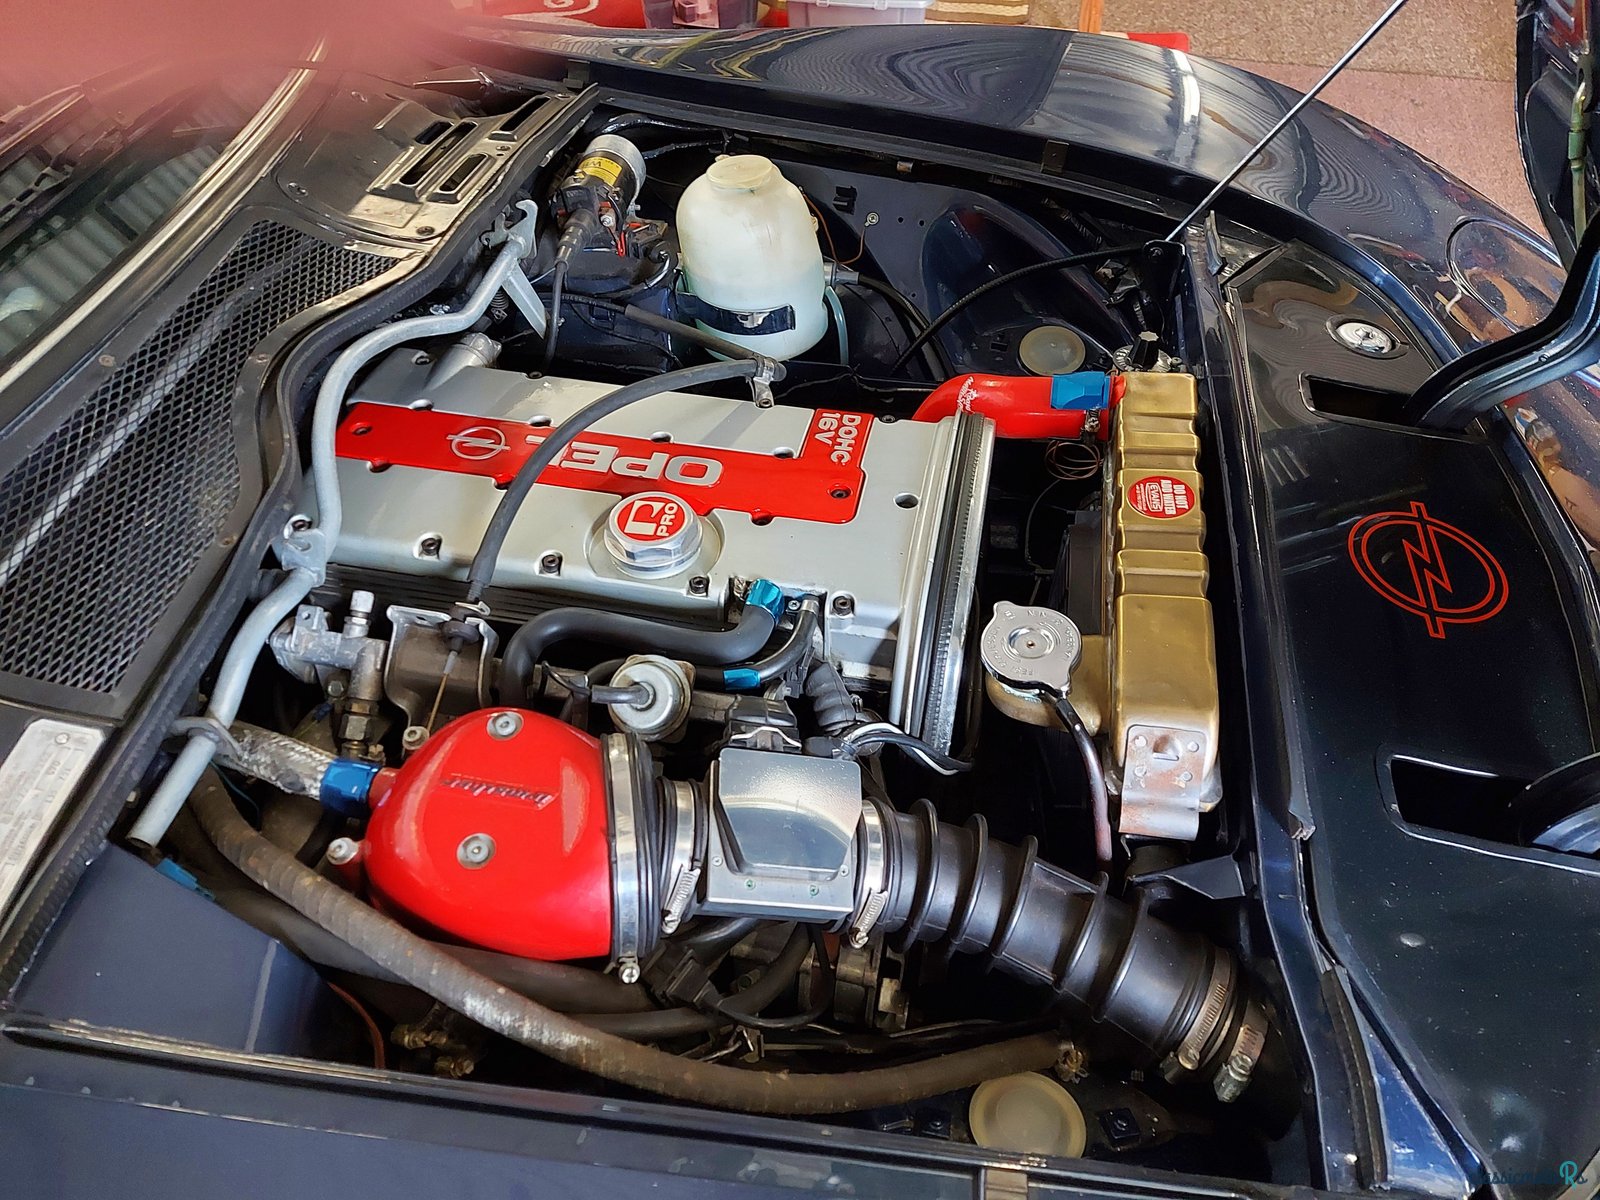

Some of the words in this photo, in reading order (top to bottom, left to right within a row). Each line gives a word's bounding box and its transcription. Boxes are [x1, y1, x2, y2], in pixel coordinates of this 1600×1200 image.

[814, 412, 841, 446] 16V
[831, 414, 862, 465] DOHC
[1150, 484, 1161, 509] EVANS
[1161, 479, 1173, 493] ADD
[1173, 484, 1187, 494] DO
[1163, 494, 1177, 514] WATER
[1175, 495, 1189, 509] NOT
[656, 502, 679, 536] PRO
